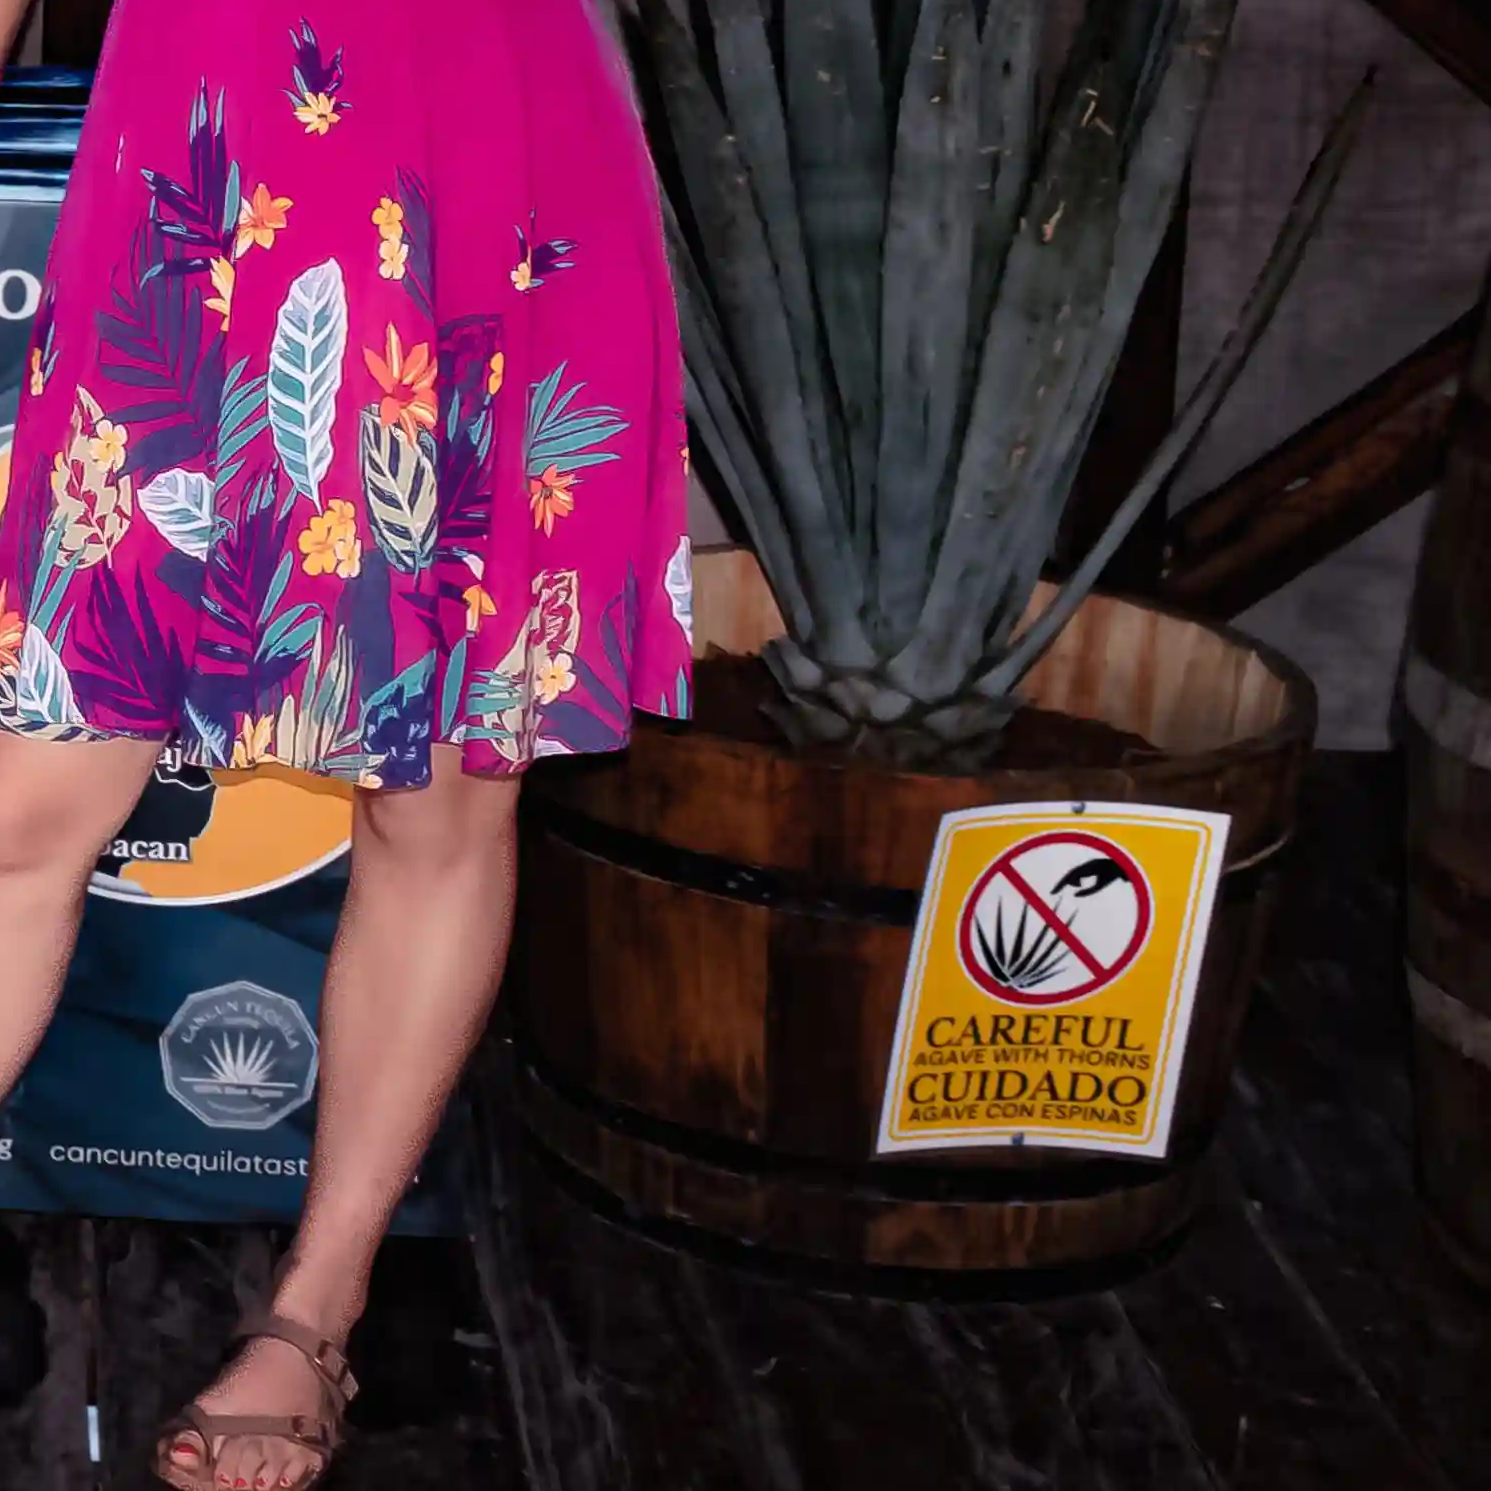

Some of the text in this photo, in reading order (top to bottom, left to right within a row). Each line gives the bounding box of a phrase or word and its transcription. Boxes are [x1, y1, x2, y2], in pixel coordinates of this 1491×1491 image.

[925, 1014, 1145, 1051] CAREFUL
[913, 1047, 1151, 1071] AGAVE WITH THORNS
[908, 1069, 1146, 1108] CUIDADO
[908, 1103, 1139, 1127] AGAVE CON ESPINAS
